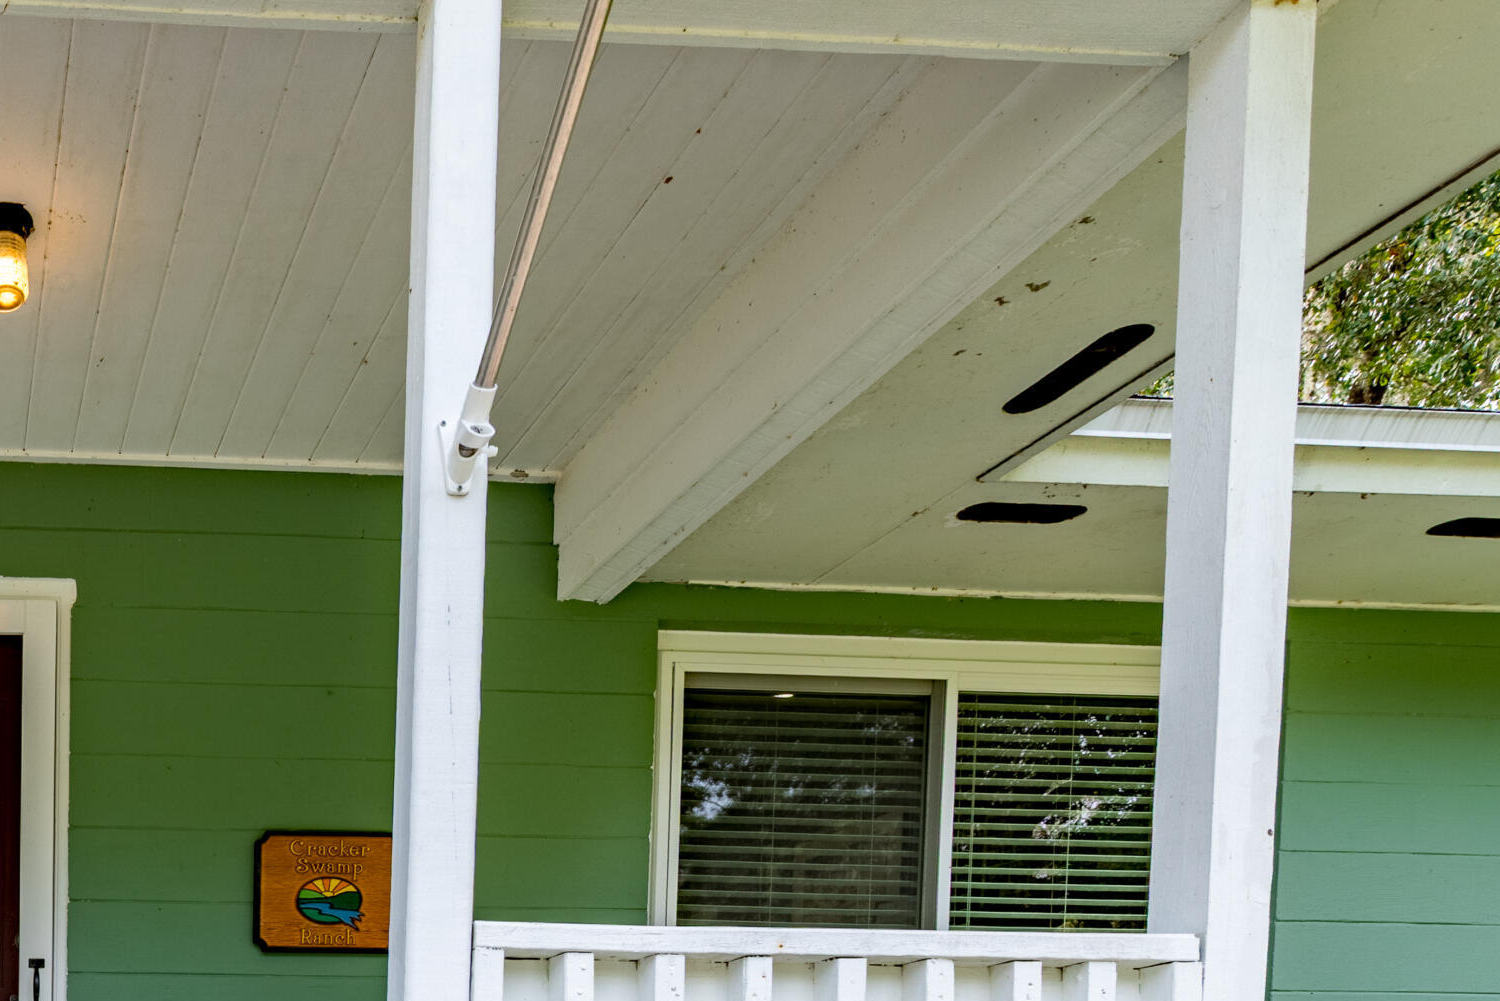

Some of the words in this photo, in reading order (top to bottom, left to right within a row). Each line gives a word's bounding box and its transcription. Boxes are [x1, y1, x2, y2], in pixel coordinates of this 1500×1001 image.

[290, 839, 371, 857] Cracker
[296, 858, 364, 880] Swamp
[301, 929, 357, 945] Ranch
